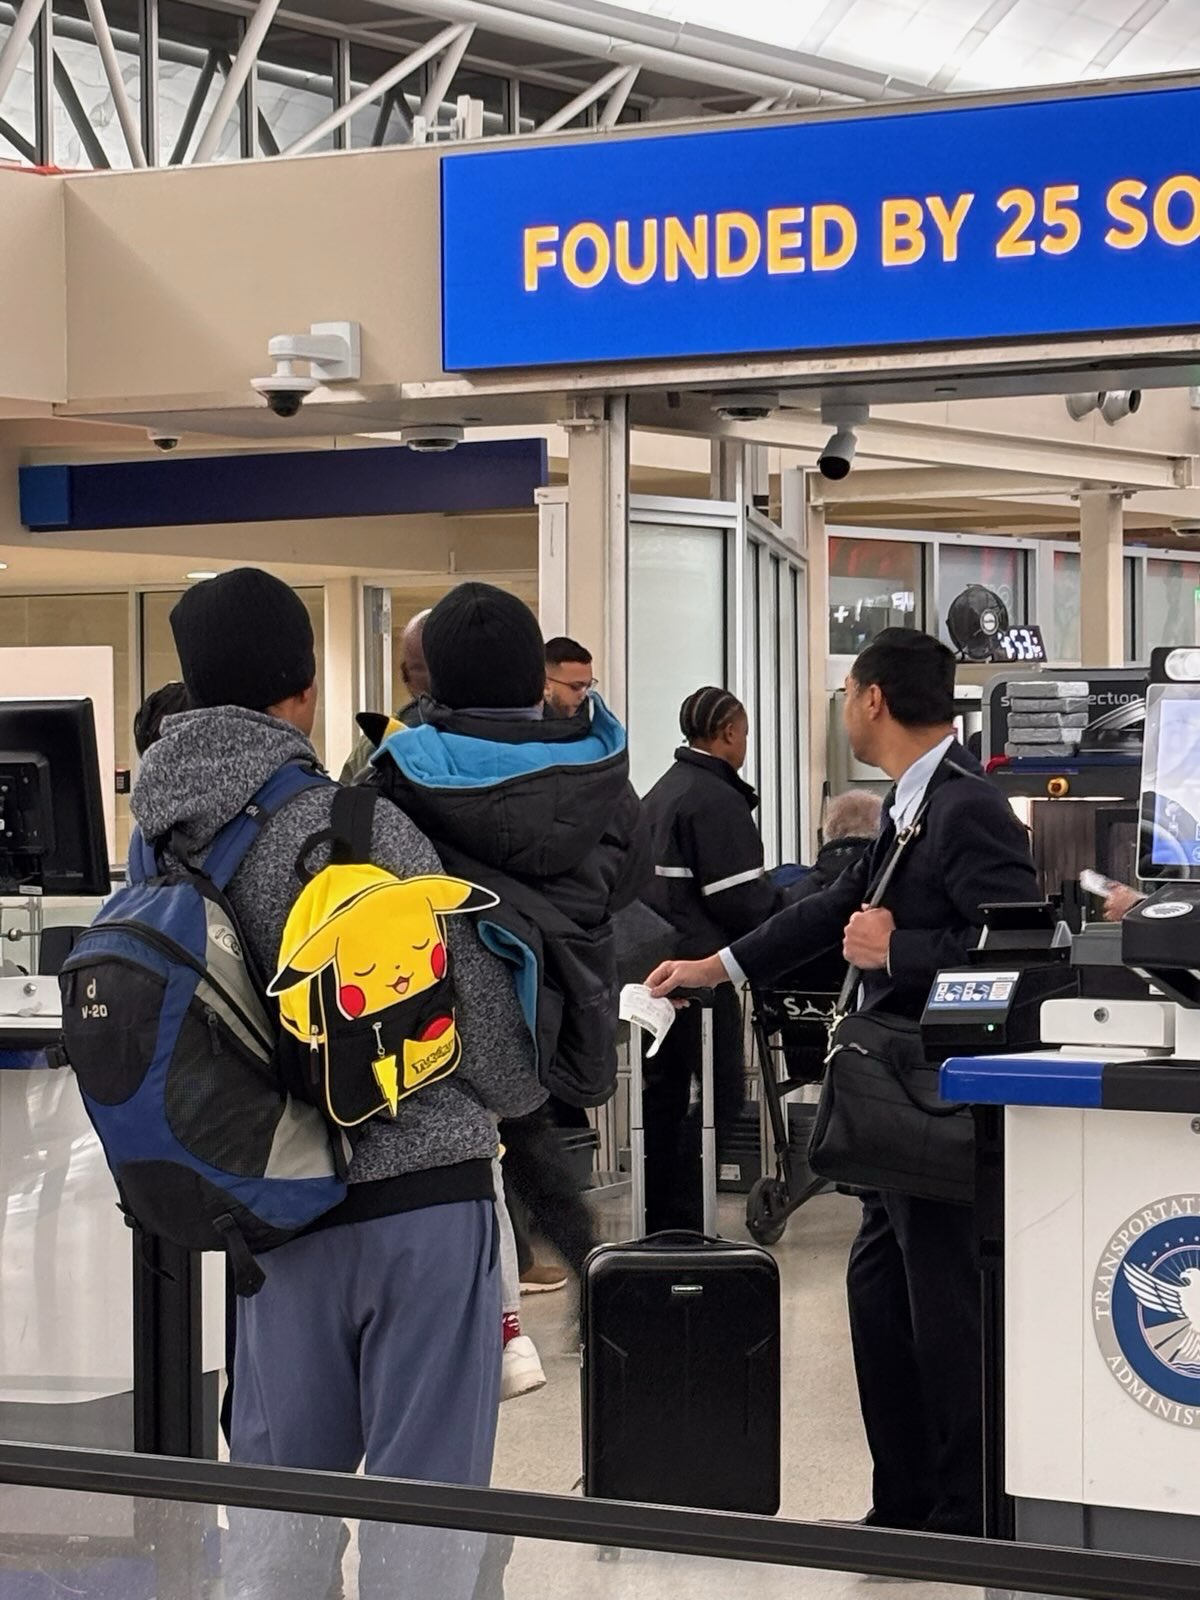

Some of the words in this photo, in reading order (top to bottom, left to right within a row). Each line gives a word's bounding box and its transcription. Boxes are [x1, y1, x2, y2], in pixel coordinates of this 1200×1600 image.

[523, 205, 857, 292] FOUNDED
[882, 194, 974, 267] BY
[996, 185, 1081, 258] 25
[1105, 176, 1200, 250] SO
[81, 1004, 108, 1019] V-20
[1094, 1197, 1200, 1321] TRANSPORTAT
